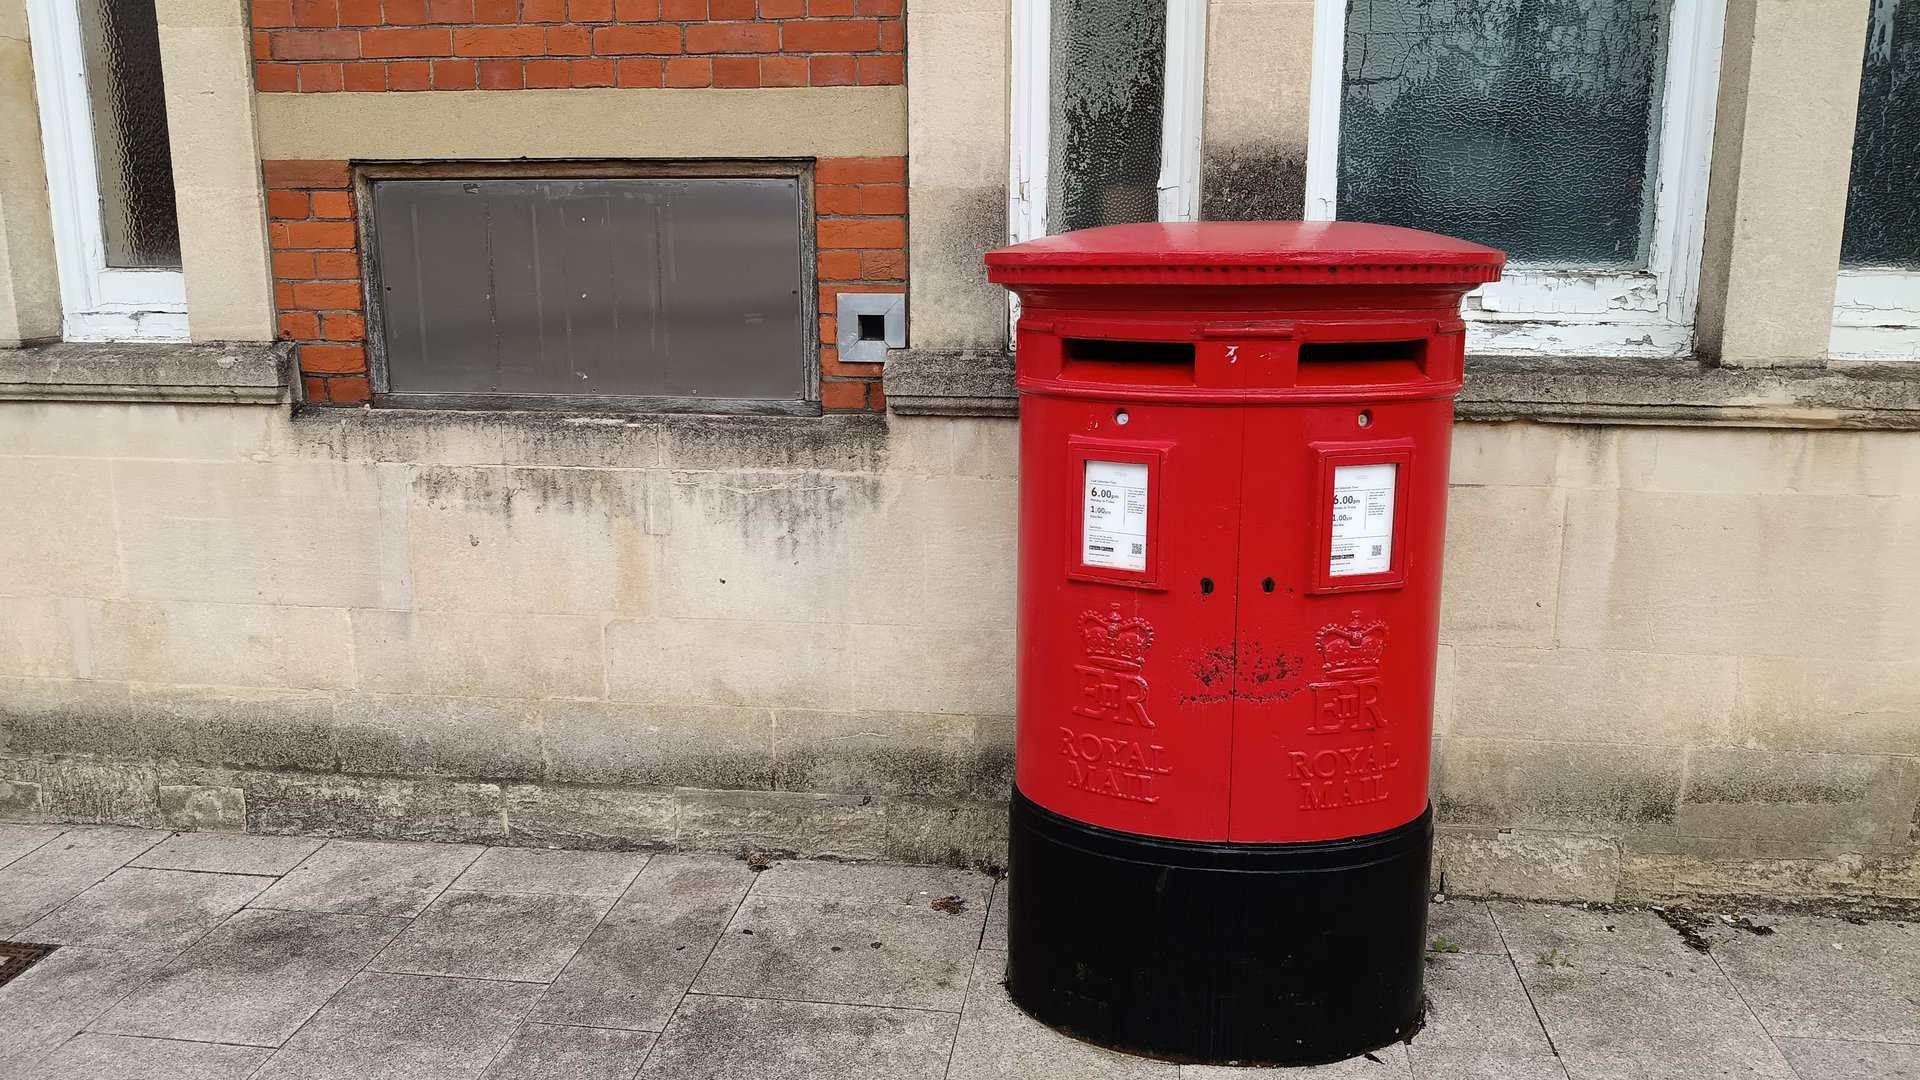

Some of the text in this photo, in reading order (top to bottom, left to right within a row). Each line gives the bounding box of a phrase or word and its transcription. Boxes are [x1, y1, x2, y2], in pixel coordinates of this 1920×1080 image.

[1091, 487, 1119, 499] 6.00pm
[1057, 726, 1173, 775] ROYAL
[1287, 742, 1400, 780] ROYAL
[1068, 760, 1160, 804] MAIL
[1299, 774, 1390, 811] MAIL
